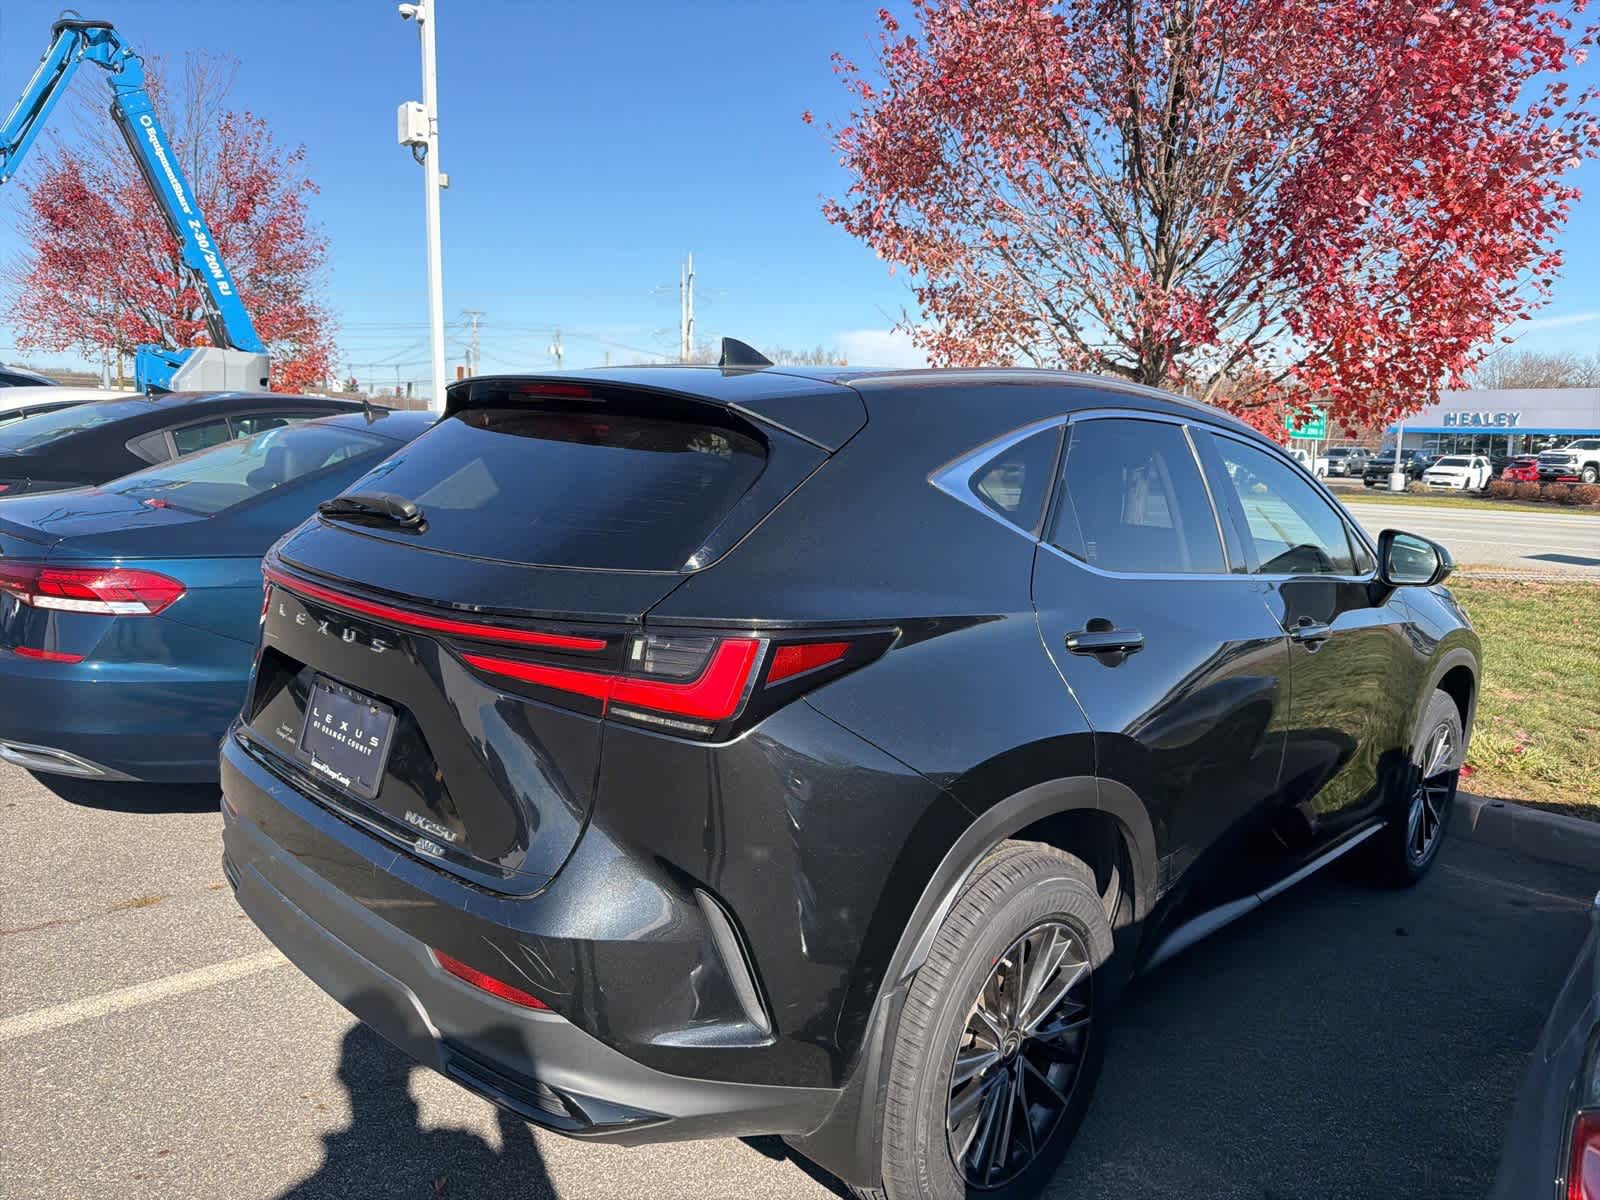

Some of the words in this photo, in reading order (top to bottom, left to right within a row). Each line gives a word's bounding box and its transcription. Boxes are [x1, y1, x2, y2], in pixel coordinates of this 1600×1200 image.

[188, 219, 225, 279] Z-30/20N
[217, 280, 232, 296] RJ
[1443, 412, 1520, 426] HEALEY
[279, 603, 388, 653] LEXUS
[313, 707, 380, 747] LEXUS
[313, 720, 321, 729] OF
[321, 725, 346, 743] ORANGE
[347, 738, 372, 756] COUNTY
